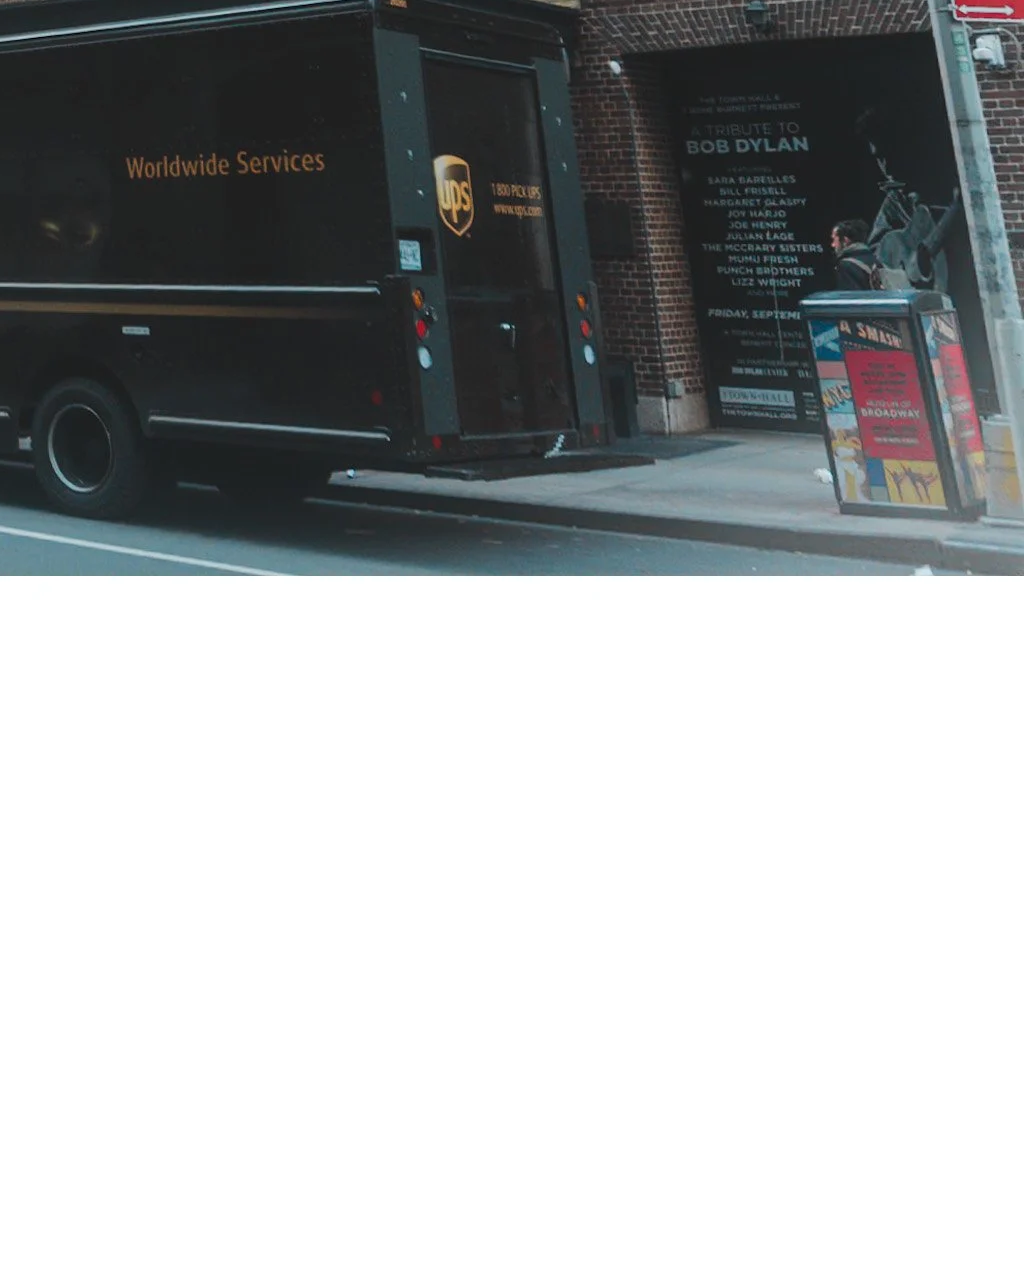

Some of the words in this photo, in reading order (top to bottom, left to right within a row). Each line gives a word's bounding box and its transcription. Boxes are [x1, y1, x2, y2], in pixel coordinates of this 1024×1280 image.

[704, 123, 773, 137] TRIBUTE
[777, 121, 800, 135] TO
[686, 139, 730, 154] BOB
[735, 136, 809, 153] DYLAN
[126, 153, 230, 180] Worldwide
[236, 149, 325, 175] Services
[441, 179, 472, 224] ups
[493, 203, 543, 219] www.ups.com
[728, 210, 747, 219] JOY
[728, 221, 748, 230] JOE
[752, 221, 788, 229] HENRY
[702, 243, 722, 252] THE
[779, 243, 824, 253] SISTERS
[717, 266, 754, 275] PUNCH
[756, 267, 815, 276] BROTHERS
[758, 278, 803, 288] WRIGHT
[708, 308, 749, 320] FRIDAY,
[861, 407, 921, 419] BROADWAY
